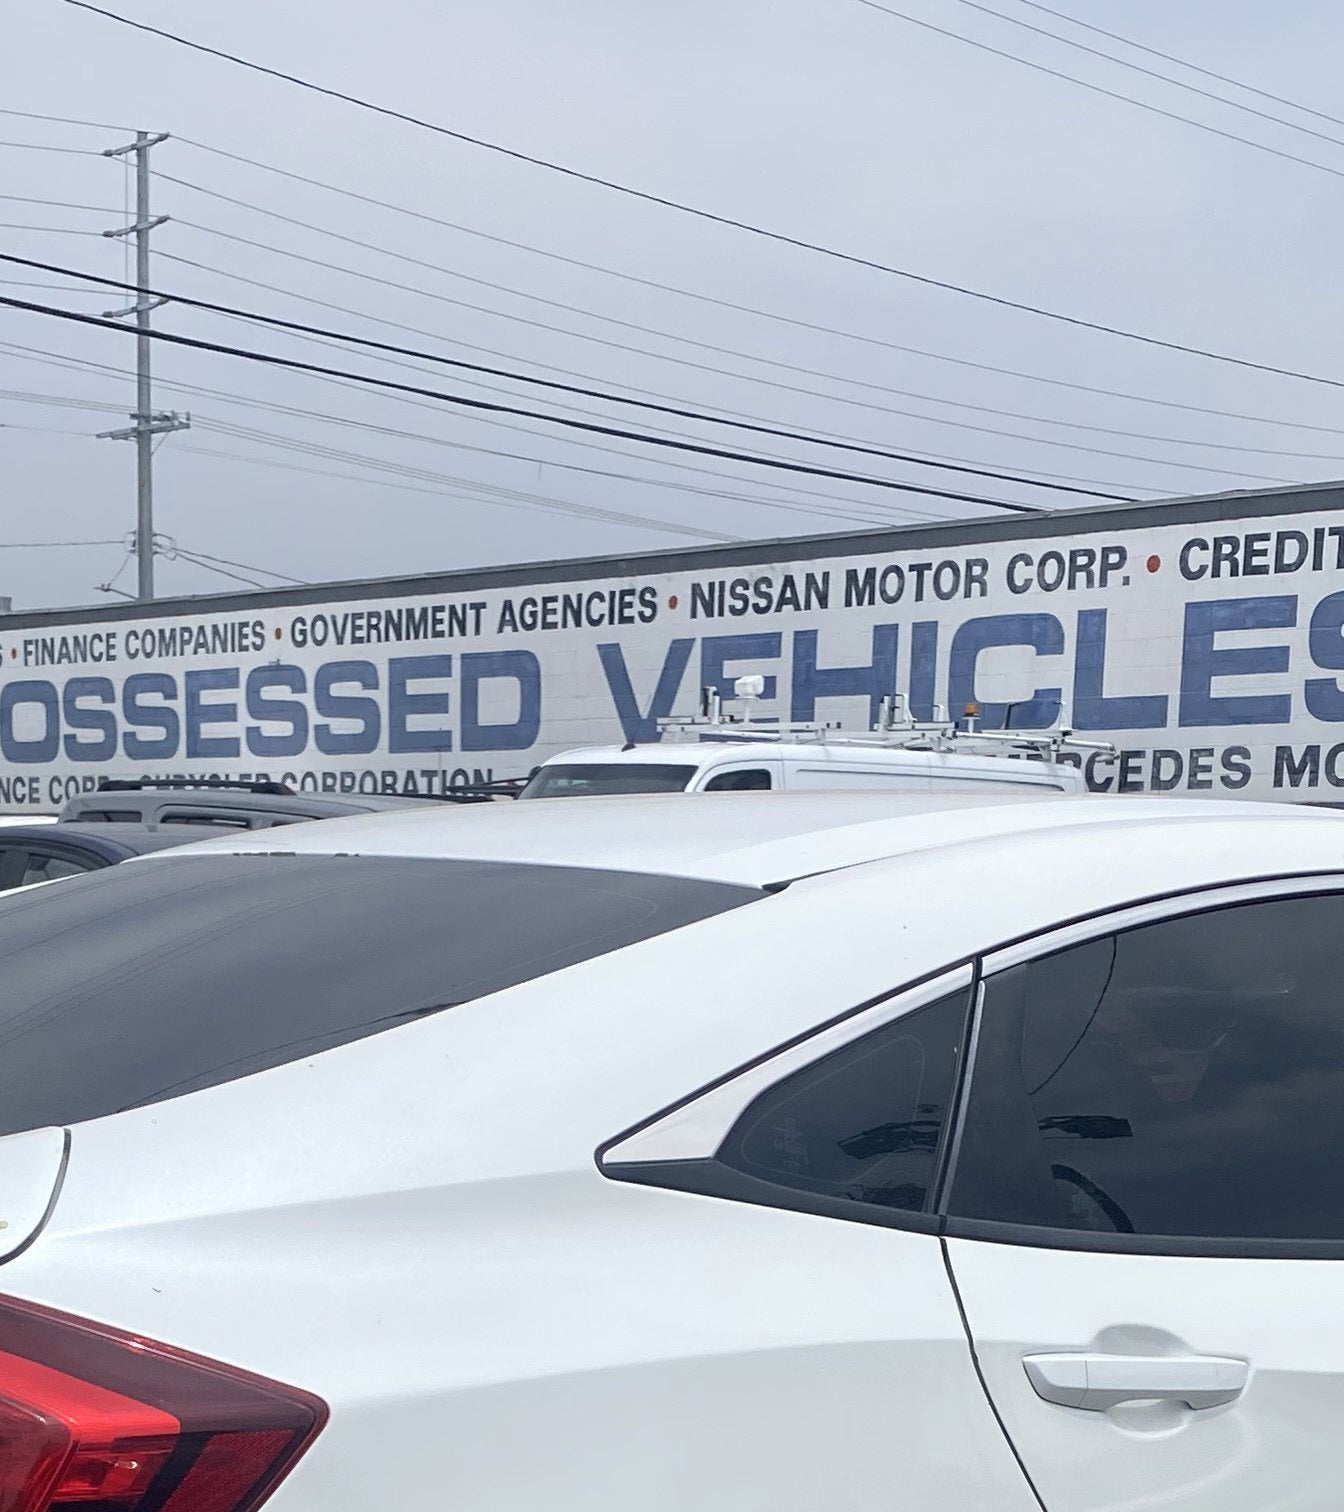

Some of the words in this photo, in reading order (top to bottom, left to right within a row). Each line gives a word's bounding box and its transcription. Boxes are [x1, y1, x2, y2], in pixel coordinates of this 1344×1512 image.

[690, 572, 831, 620] NISSAN
[844, 556, 989, 608] MOTOR
[1006, 545, 1131, 595] CORP.
[23, 632, 117, 667] FINANCE
[125, 620, 266, 661] COMPANIES
[291, 602, 487, 648] GOVERNMENT
[497, 586, 658, 634] AGENCIES
